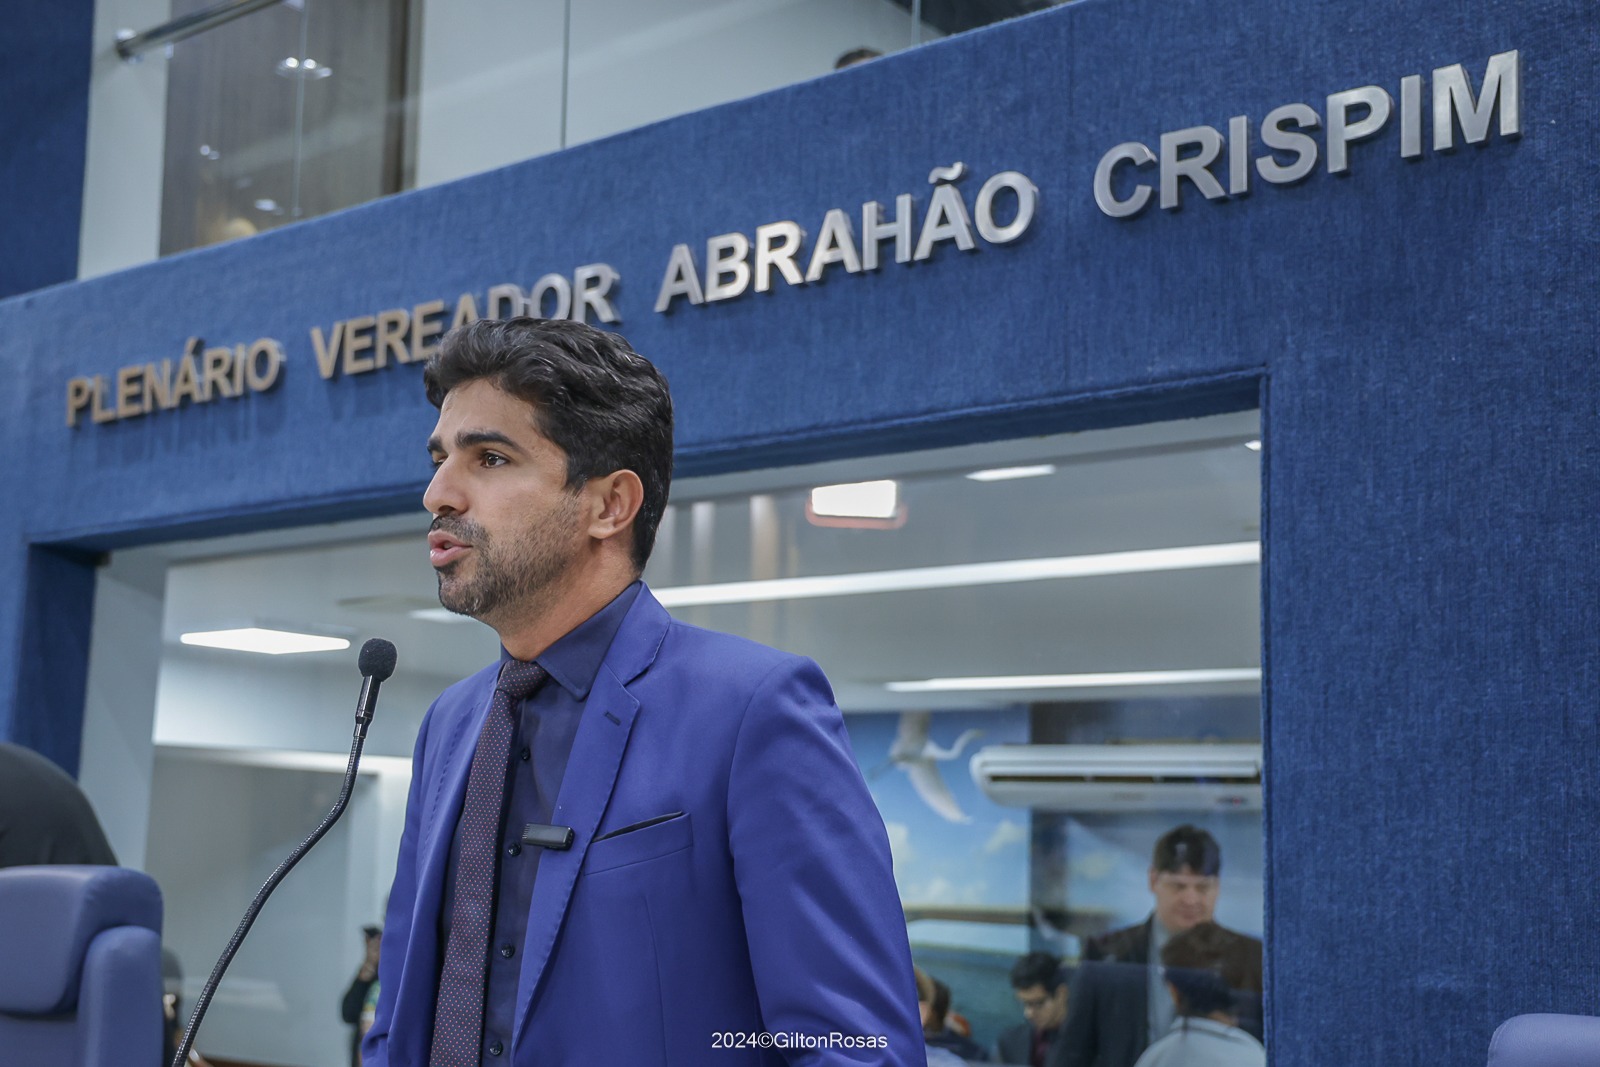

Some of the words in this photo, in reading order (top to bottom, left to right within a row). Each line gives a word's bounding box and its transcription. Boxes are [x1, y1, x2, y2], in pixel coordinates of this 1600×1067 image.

[66, 337, 284, 427] PLENÁRIO
[654, 161, 1039, 313] ABRAHÃO
[1093, 49, 1522, 218] CRISPIM
